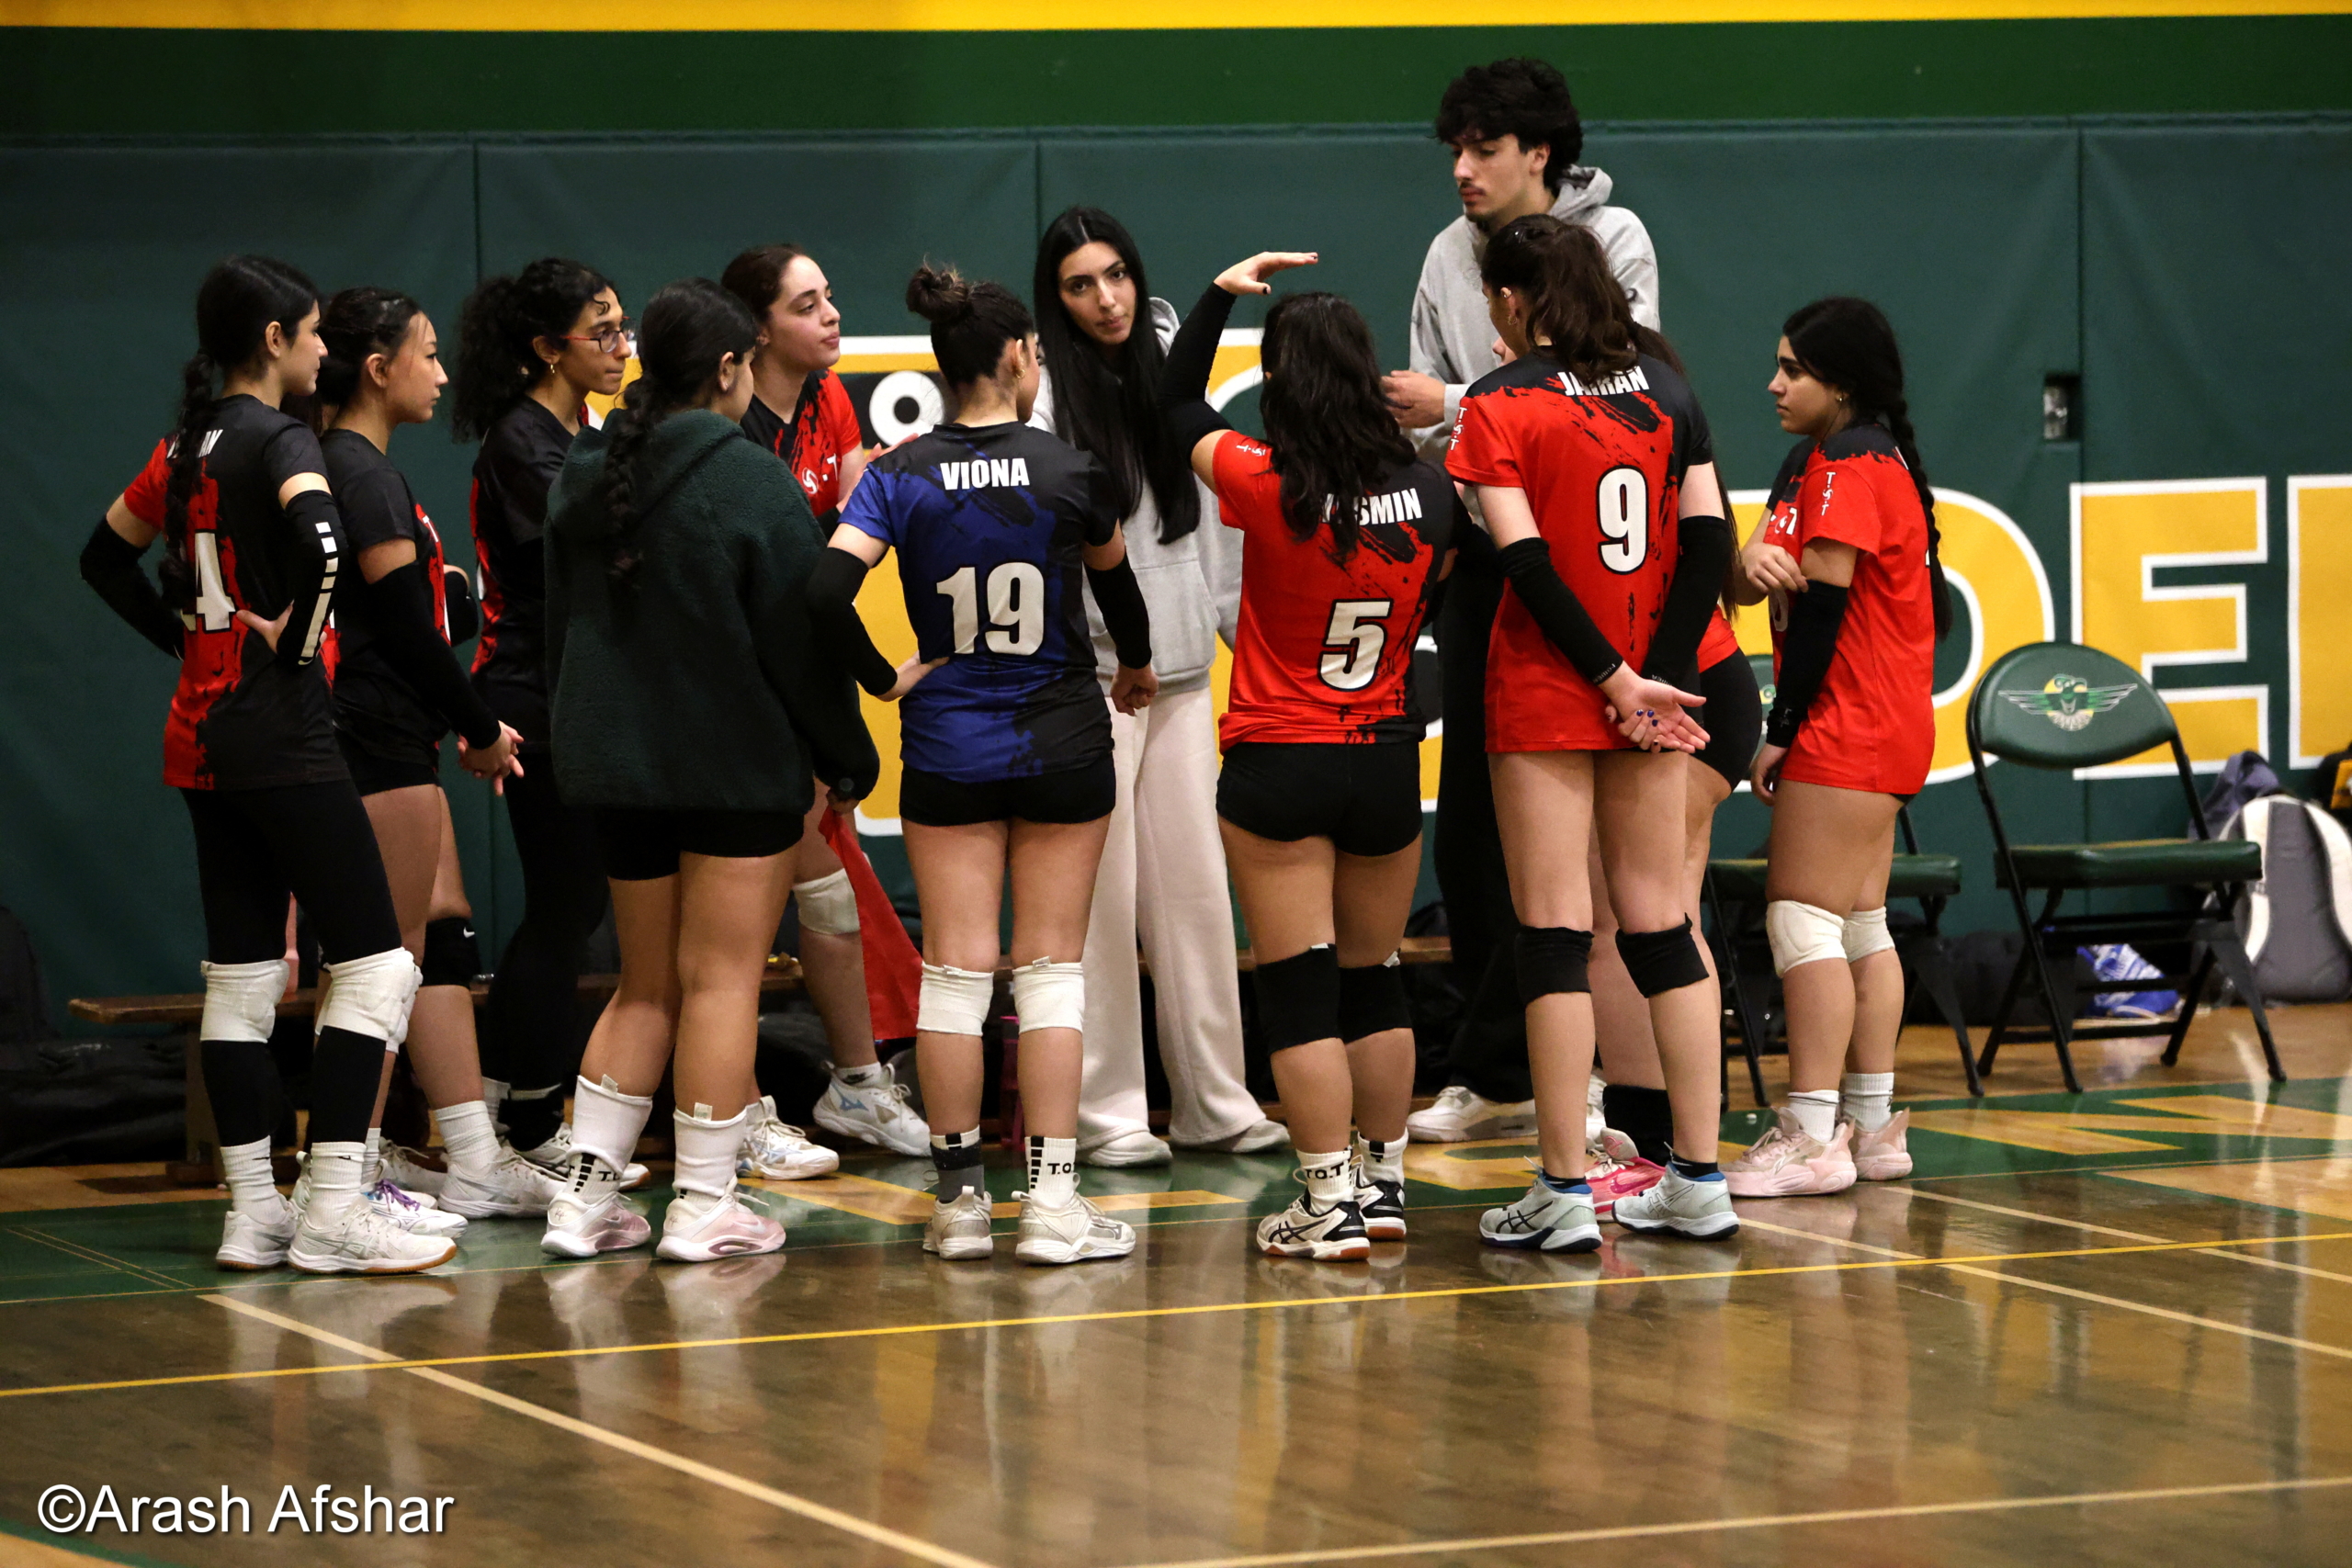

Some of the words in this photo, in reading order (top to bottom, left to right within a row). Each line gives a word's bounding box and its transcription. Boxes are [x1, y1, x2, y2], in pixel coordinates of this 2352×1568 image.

[940, 458, 1030, 491] VIONA
[1321, 487, 1423, 526] SMIN
[1598, 465, 1648, 573] 9
[936, 561, 1045, 656] 19
[1319, 599, 1393, 691] 5
